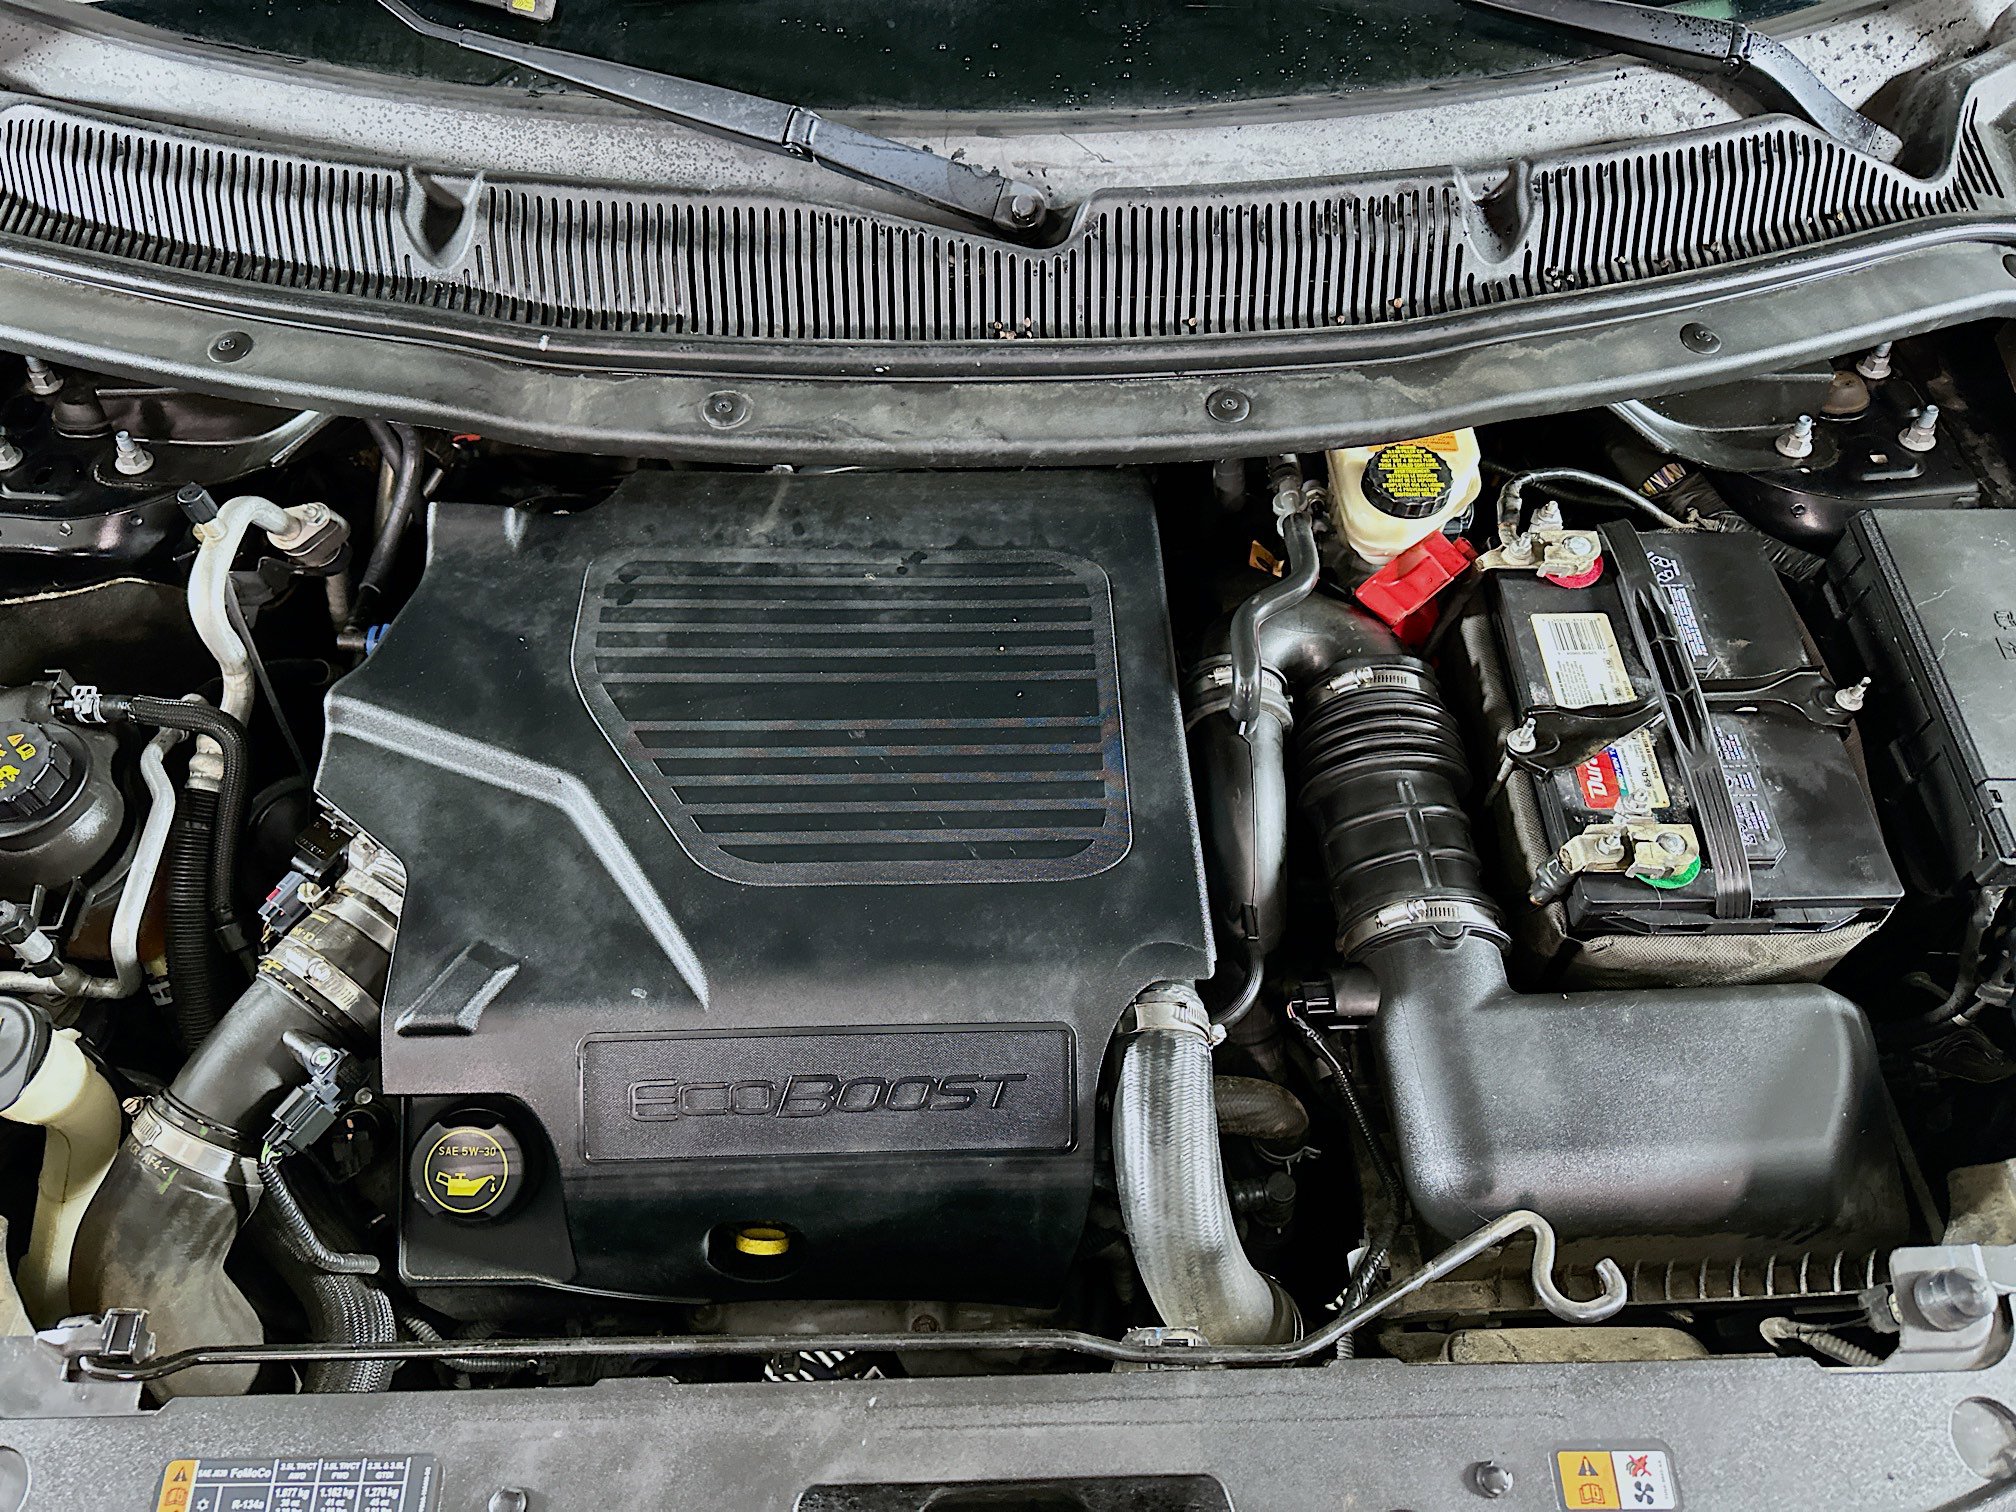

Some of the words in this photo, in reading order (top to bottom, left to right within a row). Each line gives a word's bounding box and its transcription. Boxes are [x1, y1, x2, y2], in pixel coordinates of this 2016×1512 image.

[438, 1145, 459, 1156] SAE
[461, 1145, 497, 1157] 5W-30
[230, 1467, 272, 1478] FoMoCo
[298, 1487, 310, 1500] kg
[343, 1486, 355, 1500] kg
[387, 1486, 400, 1500] kg
[231, 1499, 265, 1510] R-134a
